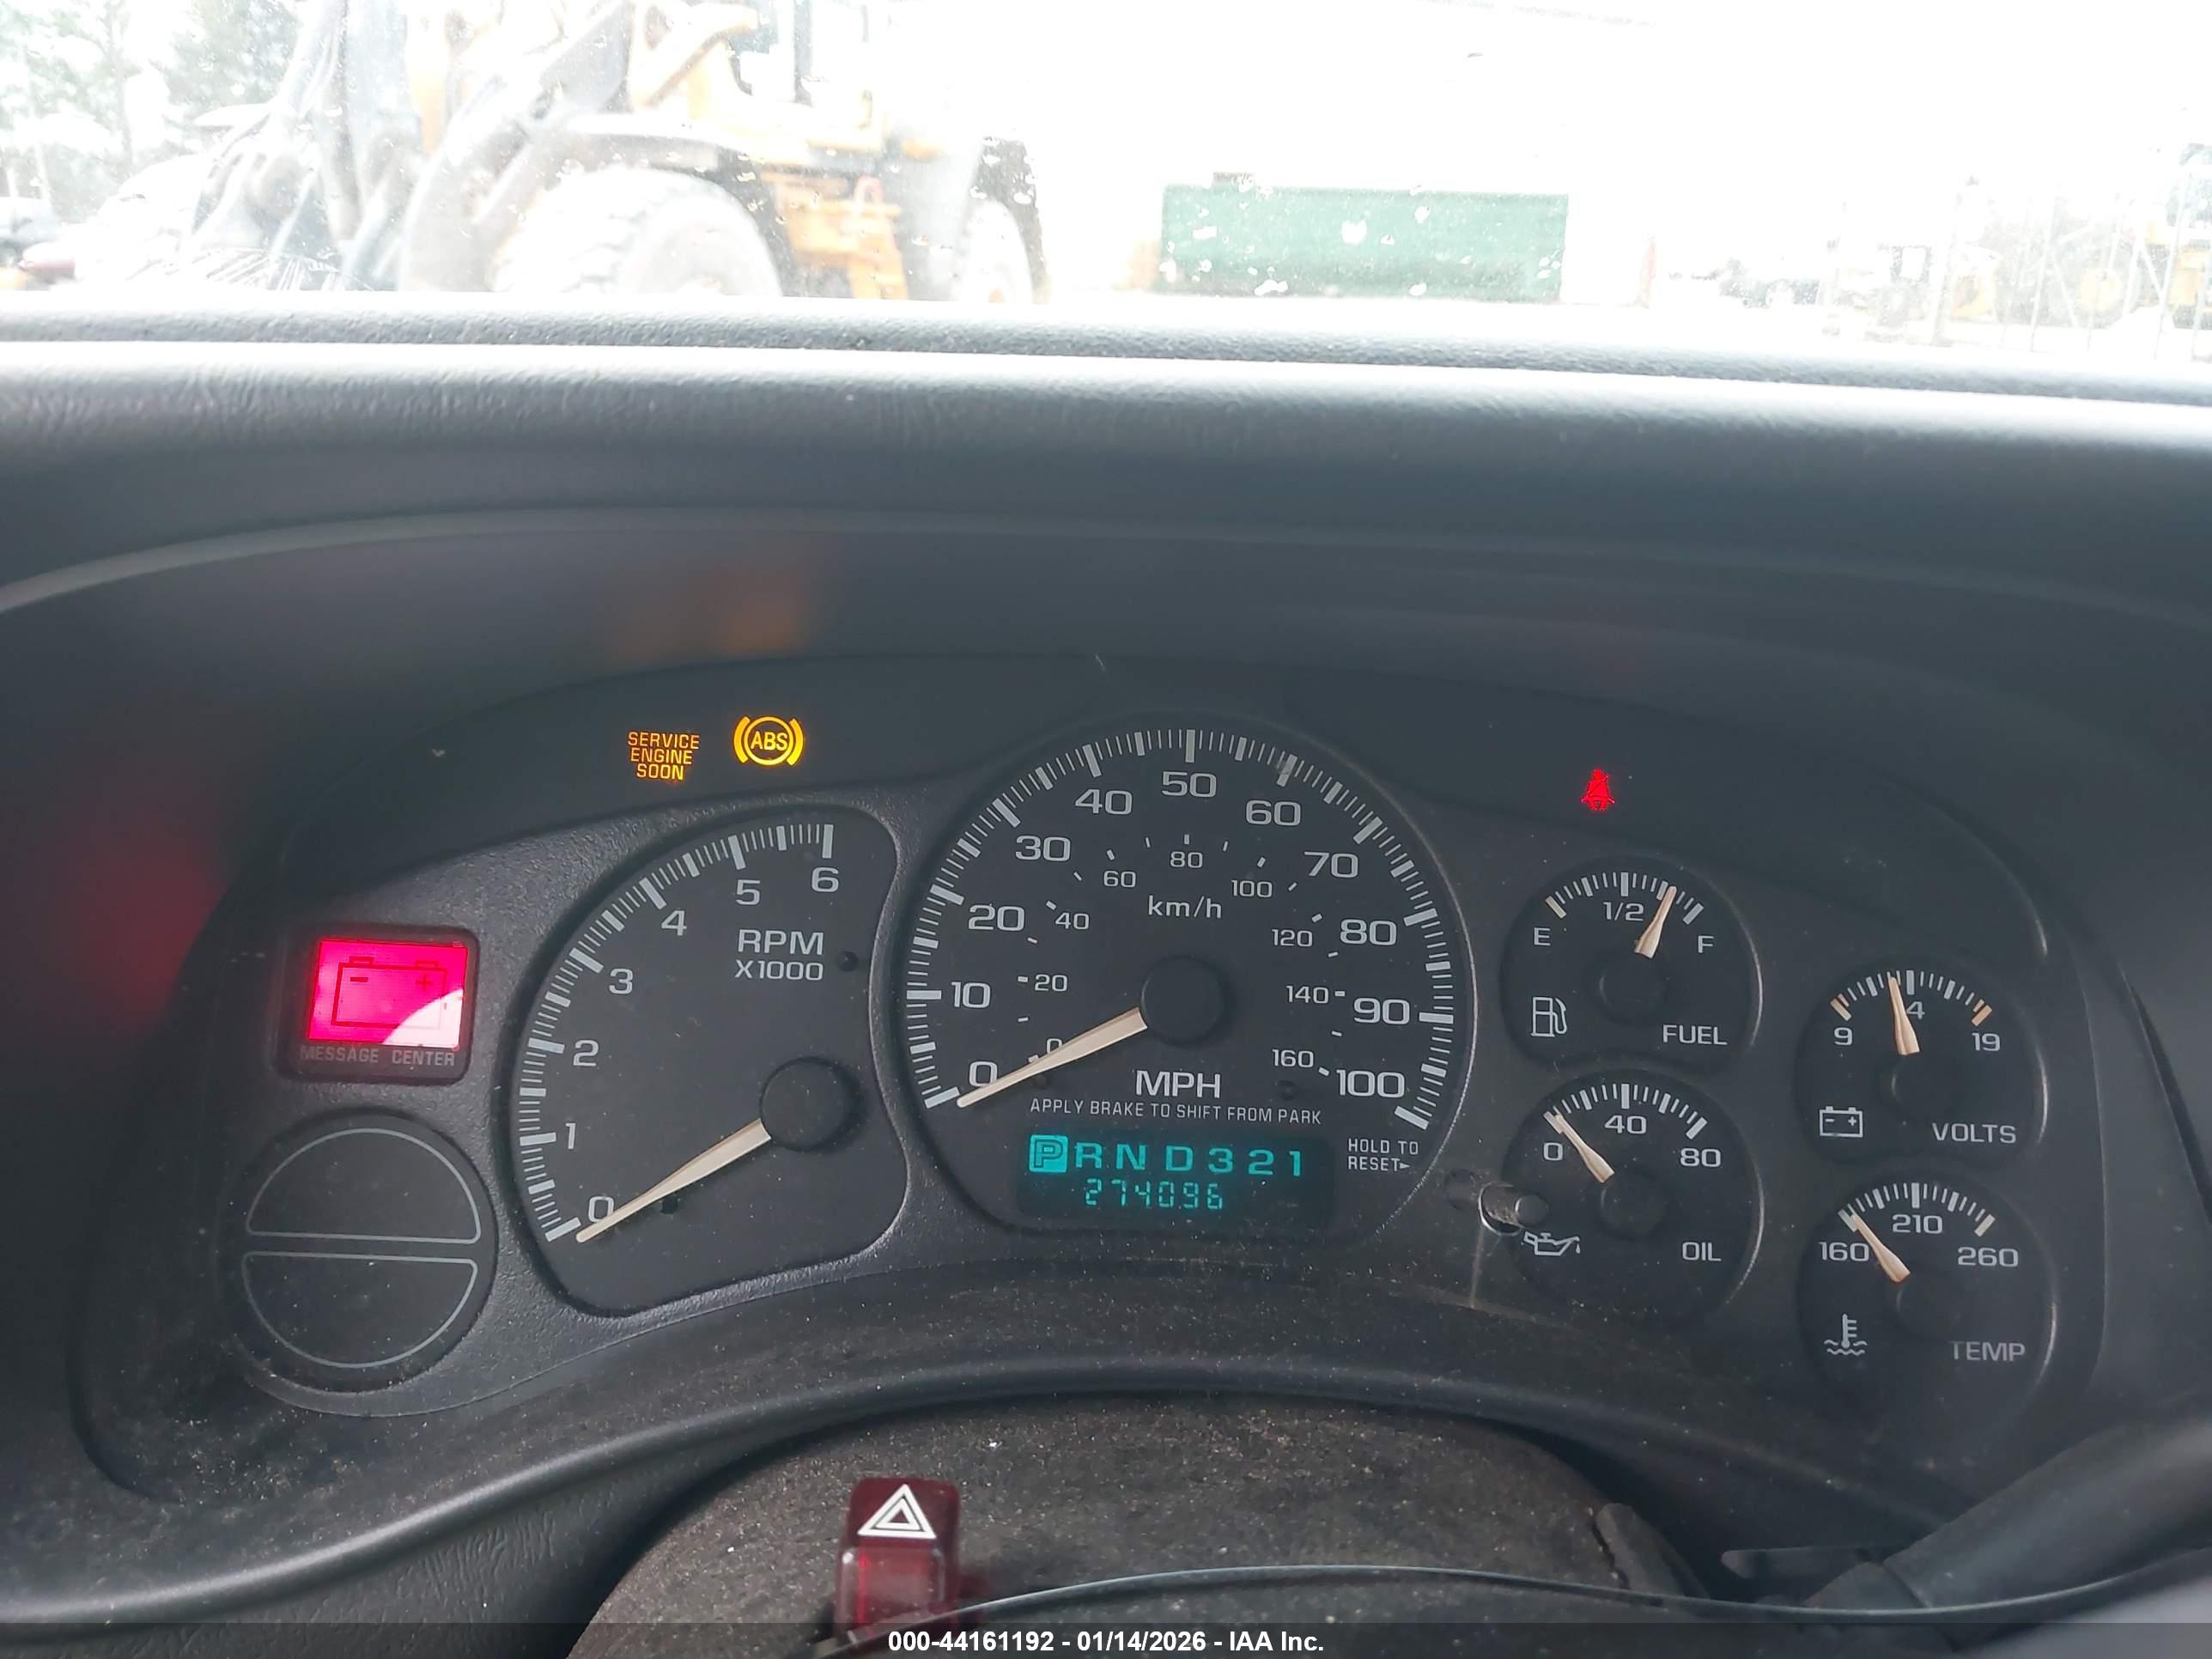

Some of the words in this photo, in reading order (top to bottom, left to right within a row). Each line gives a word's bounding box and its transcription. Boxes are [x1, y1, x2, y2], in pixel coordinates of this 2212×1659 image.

[628, 732, 701, 750] SERVICE
[750, 731, 788, 750] ABS
[630, 748, 693, 765] ENGINE
[636, 763, 684, 781] SOON
[1161, 771, 1217, 798] 50
[1074, 788, 1133, 815] 40
[1245, 799, 1301, 826] 60
[1015, 836, 1071, 861] 30
[1170, 851, 1203, 869] 80
[1304, 851, 1359, 878] 70
[811, 866, 840, 893] 6
[1103, 870, 1137, 888] 60
[1231, 879, 1273, 898] 100
[735, 878, 761, 905] 5
[1147, 895, 1223, 919] km/h
[1602, 902, 1644, 921] 1/2
[660, 909, 687, 936] 4
[968, 904, 1025, 932] 20
[1054, 912, 1090, 930] 40
[737, 928, 825, 956] RPM
[1271, 928, 1314, 947] 120
[1340, 918, 1397, 945] 80
[1534, 927, 1551, 946] E
[1697, 935, 1714, 953] F
[734, 959, 824, 981] X1000
[608, 968, 634, 995] 3
[1034, 974, 1068, 992] 20
[951, 981, 991, 1009] 10
[1286, 985, 1329, 1005] 140
[1353, 997, 1410, 1024] 90
[1899, 1000, 1926, 1020] 4
[1662, 1024, 1728, 1045] FUEL
[1833, 1027, 1854, 1046] 9
[1972, 1032, 2002, 1052] 19
[301, 1043, 379, 1064] MESSAGE
[392, 1049, 455, 1067] CENTER
[572, 1040, 599, 1066] 2
[1046, 1037, 1063, 1054] 0
[1272, 1048, 1315, 1068] 160
[969, 1060, 998, 1088] 0
[1135, 1069, 1222, 1099] MPH
[1336, 1069, 1406, 1098] 100
[1030, 1097, 1084, 1115] APPLY
[1090, 1101, 1144, 1117] BRAKE
[1151, 1103, 1170, 1118] TO
[1176, 1103, 1222, 1121] SHIFT
[1227, 1106, 1272, 1123] FROM
[1278, 1109, 1322, 1126] PARK
[565, 1121, 577, 1150] 1
[1604, 1115, 1648, 1135] 40
[1932, 1122, 2017, 1145] VOLTS
[1035, 1139, 1064, 1168] P
[1076, 1142, 1103, 1169] R
[1116, 1144, 1146, 1170] N
[1165, 1145, 1194, 1172] D
[1208, 1147, 1234, 1174] 3
[1249, 1149, 1275, 1176] 2
[1289, 1150, 1302, 1176] 1
[1347, 1138, 1390, 1155] HOLD
[1397, 1140, 1419, 1156] TO
[1543, 1142, 1564, 1162] 0
[1680, 1147, 1722, 1168] 80
[1347, 1156, 1401, 1171] RESET
[1085, 1178, 1224, 1211] 274096
[587, 1195, 615, 1224] 0
[1892, 1214, 1944, 1235] 210
[1681, 1242, 1723, 1261] OIL
[1819, 1242, 1870, 1262] 160
[1957, 1247, 2019, 1267] 260
[1949, 1340, 2027, 1363] TEMP
